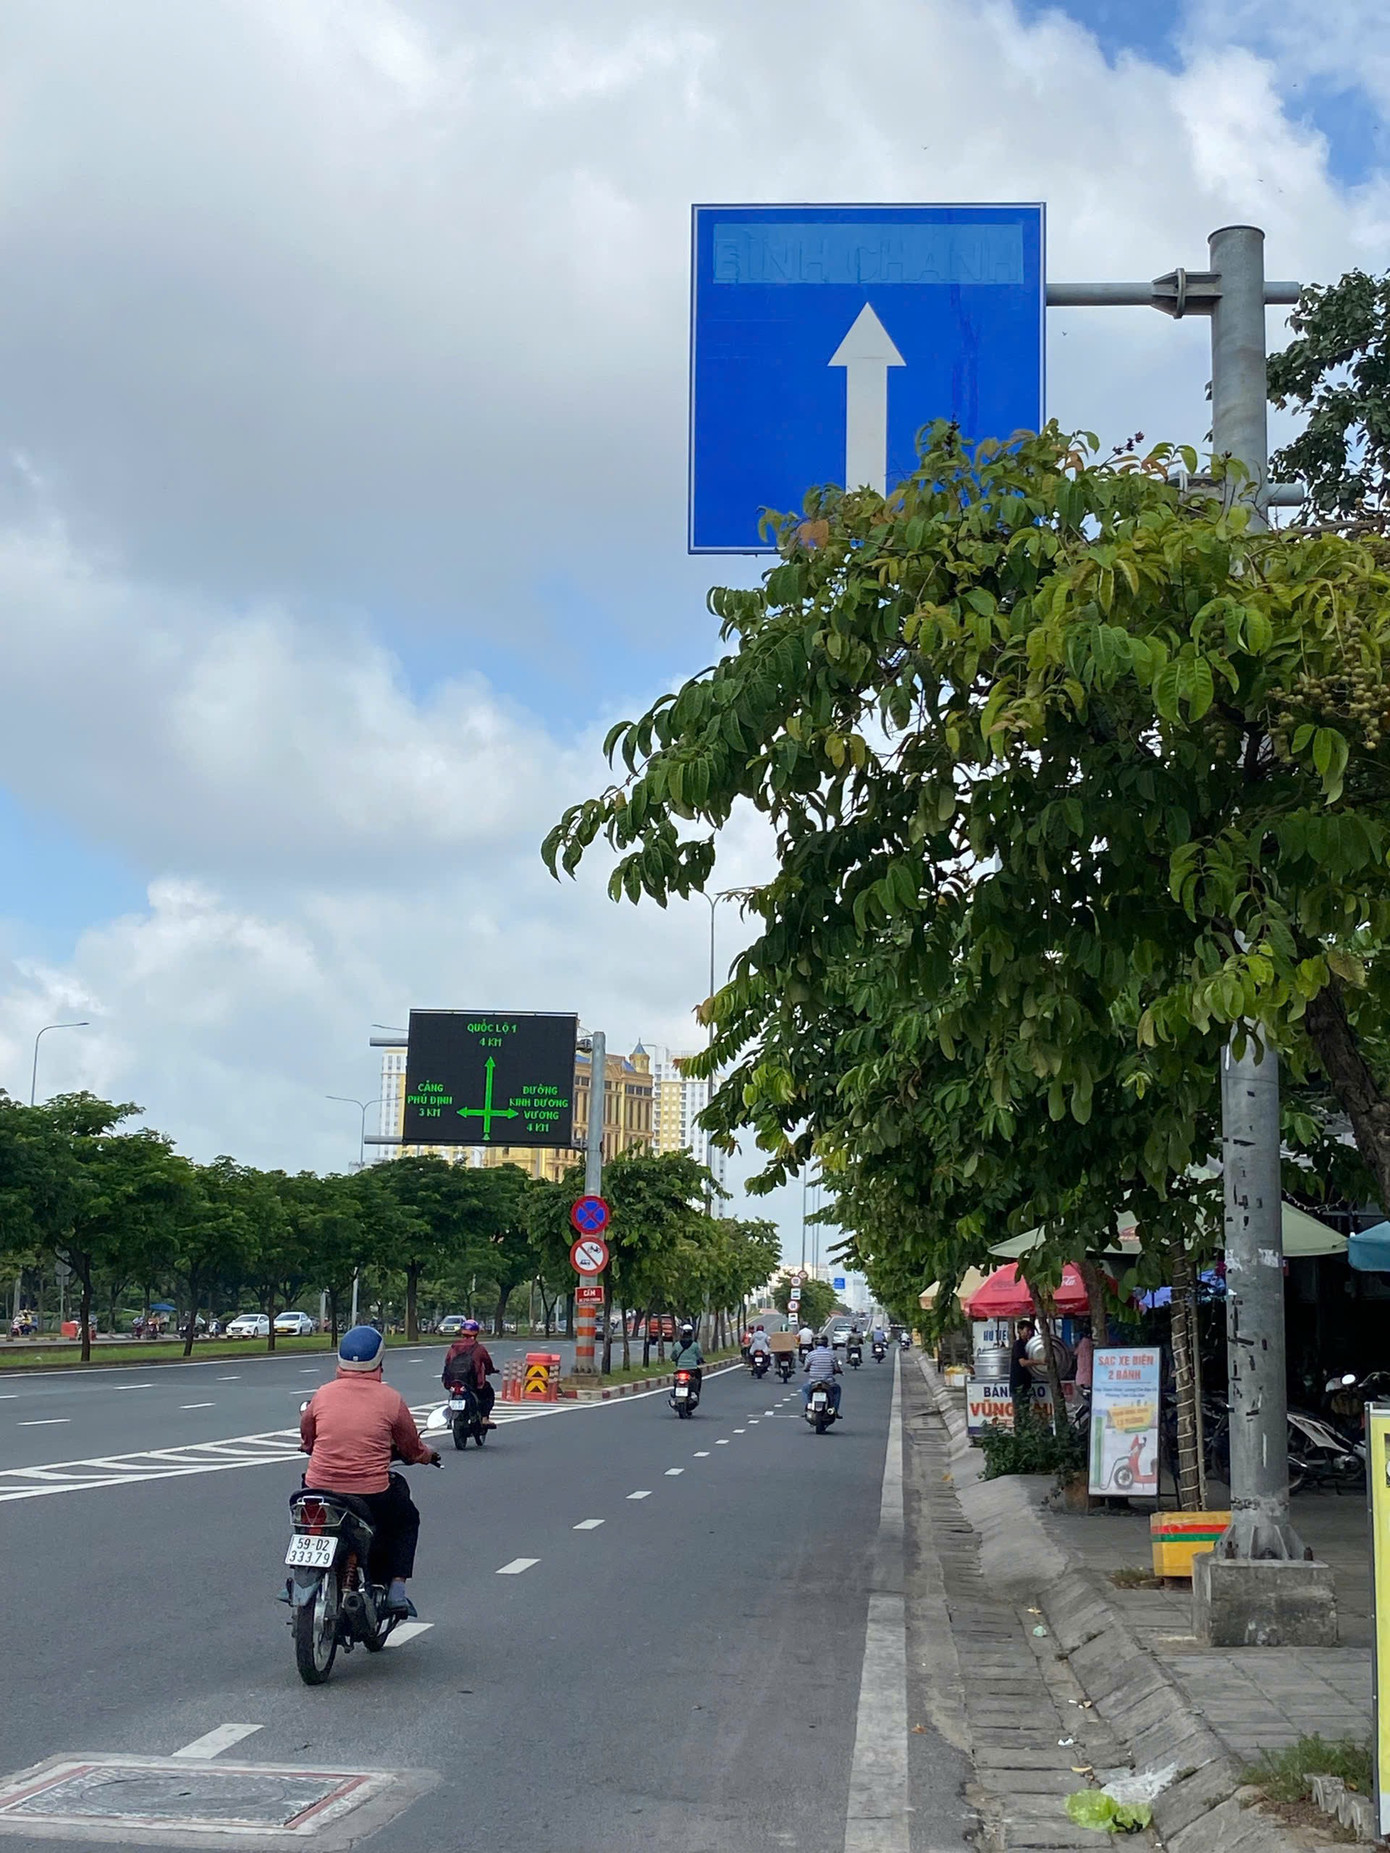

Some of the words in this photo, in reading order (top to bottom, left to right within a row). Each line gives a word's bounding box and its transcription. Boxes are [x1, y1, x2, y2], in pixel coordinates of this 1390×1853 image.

[511, 1024, 517, 1033] 1
[479, 1037, 486, 1046] 4
[488, 1037, 502, 1047] KM
[407, 1093, 428, 1104] PHÚ
[419, 1108, 425, 1117] 3
[426, 1108, 441, 1117] KM
[526, 1123, 533, 1132] 4
[535, 1123, 549, 1132] KM
[1119, 1355, 1130, 1366] XE
[1108, 1370, 1114, 1380] 2
[984, 1383, 1011, 1398] BÁN
[297, 1538, 330, 1551] 59-D2
[289, 1550, 330, 1564] 333.79
